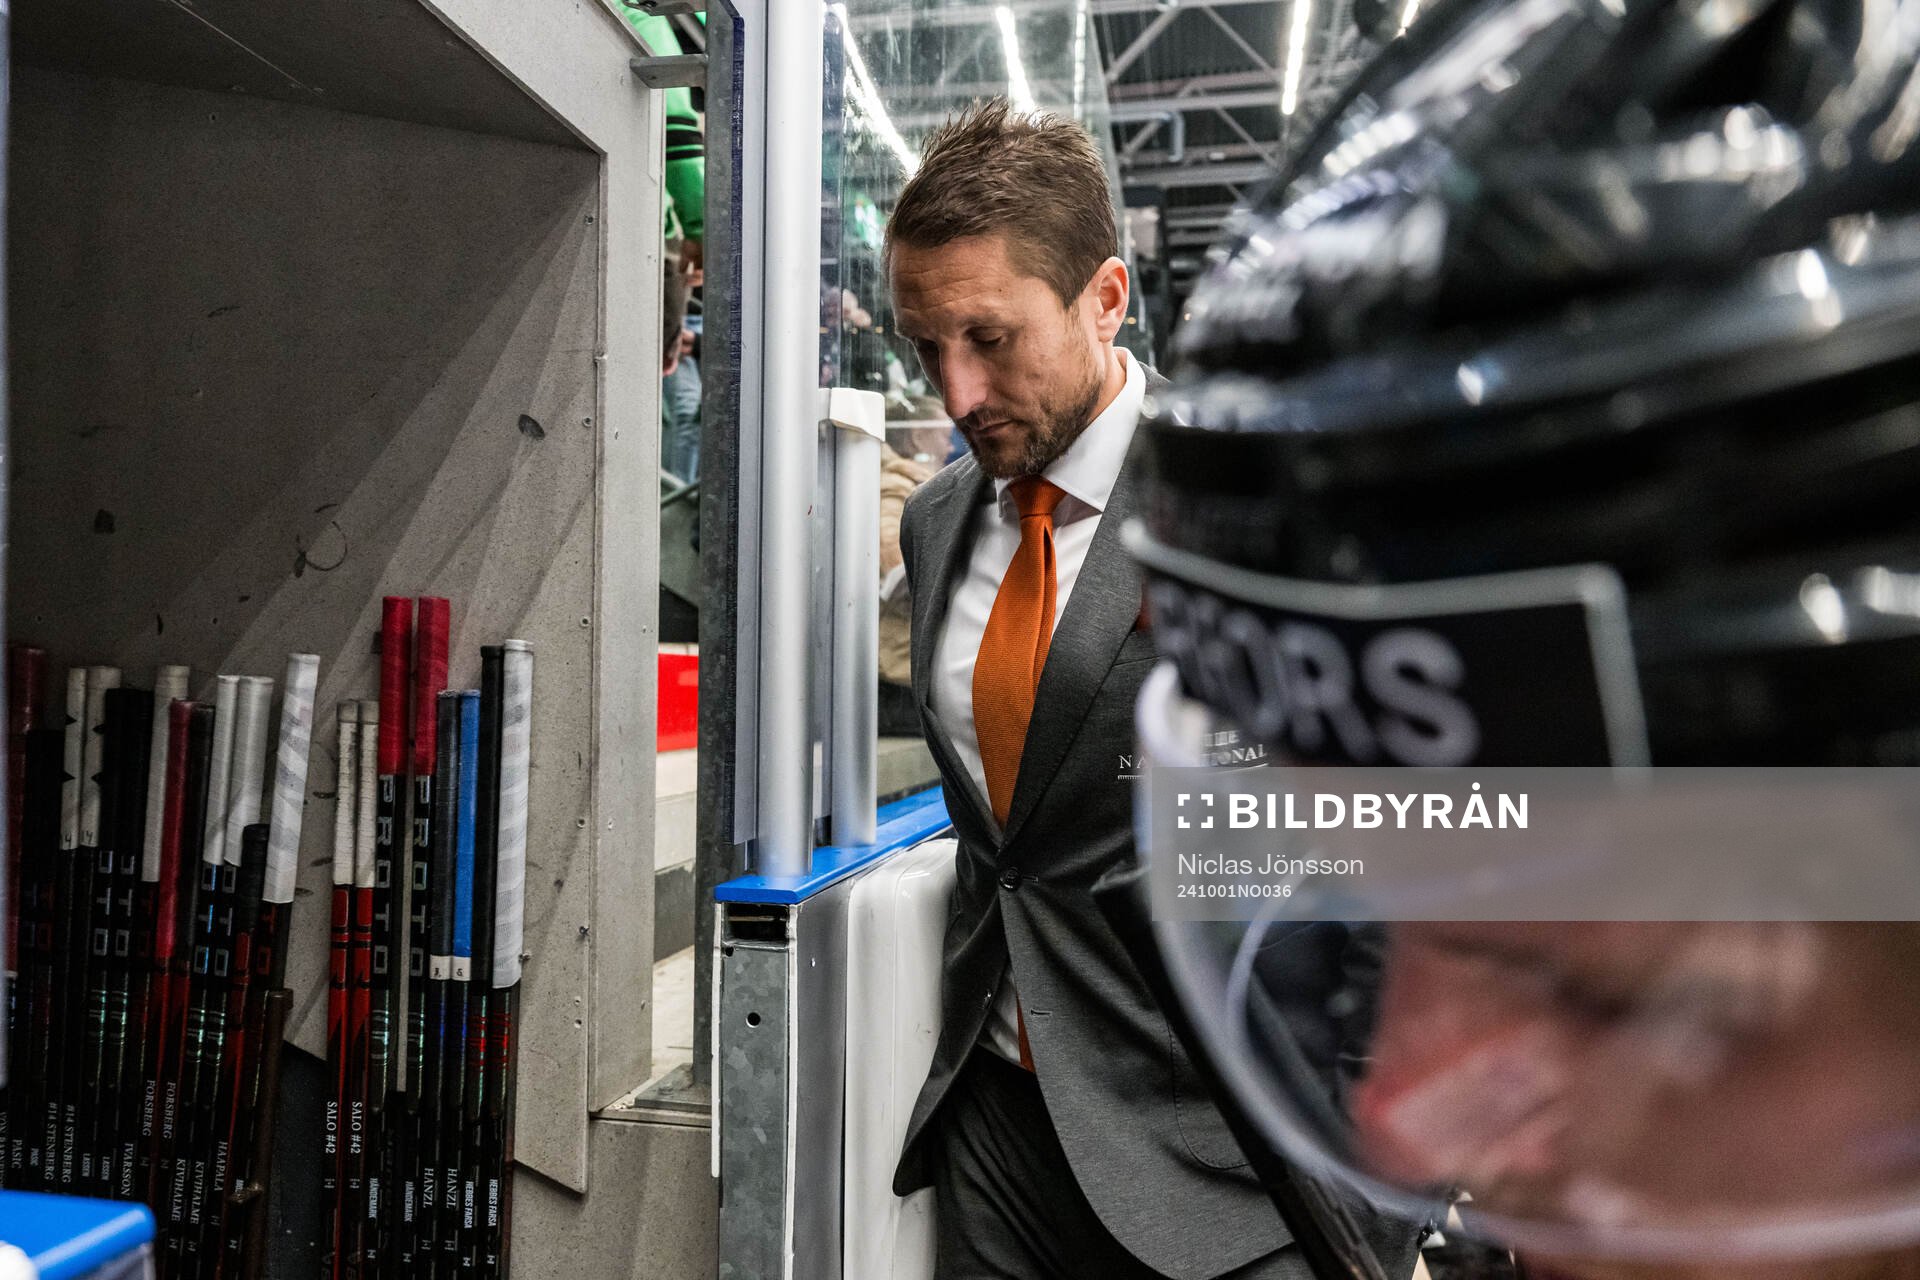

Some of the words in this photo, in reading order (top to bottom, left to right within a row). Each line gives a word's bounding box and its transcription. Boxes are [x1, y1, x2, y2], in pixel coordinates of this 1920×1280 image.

[374, 775, 394, 975] PROTO
[410, 776, 430, 977] PROTO
[142, 1079, 156, 1137] FORSBERG
[162, 1081, 177, 1140] FORSBERG
[326, 1101, 338, 1131] SALO
[351, 1101, 363, 1131] SALO
[44, 1124, 57, 1181] STENBERG
[62, 1126, 75, 1183] STENBERG
[121, 1142, 136, 1197] IVARSSON
[214, 1141, 228, 1191] HAAPALA
[325, 1134, 336, 1154] #42
[350, 1134, 361, 1154] #42
[171, 1157, 187, 1222] KIVIHALME
[190, 1160, 205, 1225] KIVIHALME
[423, 1168, 434, 1209] HANZL
[446, 1168, 458, 1209] HANZL
